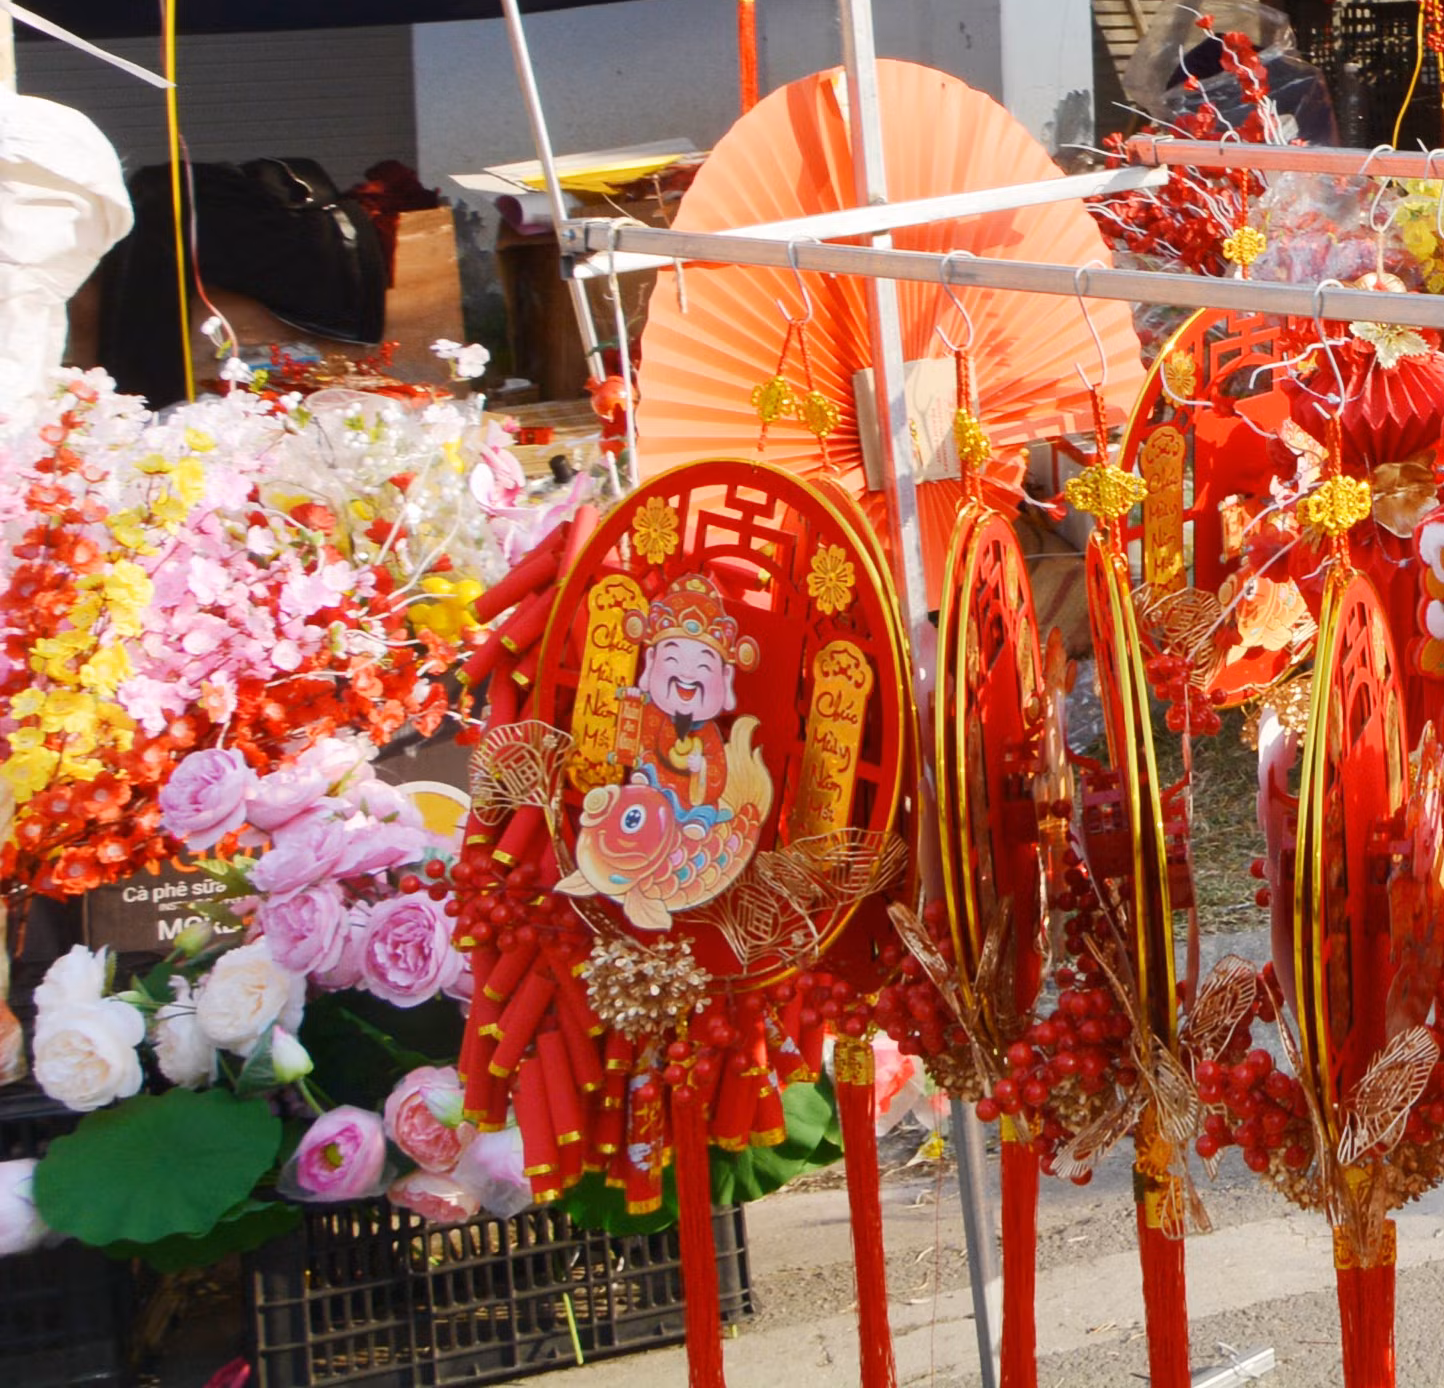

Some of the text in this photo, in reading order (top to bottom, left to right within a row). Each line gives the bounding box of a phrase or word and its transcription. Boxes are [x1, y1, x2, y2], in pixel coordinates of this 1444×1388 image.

[815, 689, 859, 725] Chúc
[122, 885, 149, 903] Cà
[152, 881, 188, 904] phê
